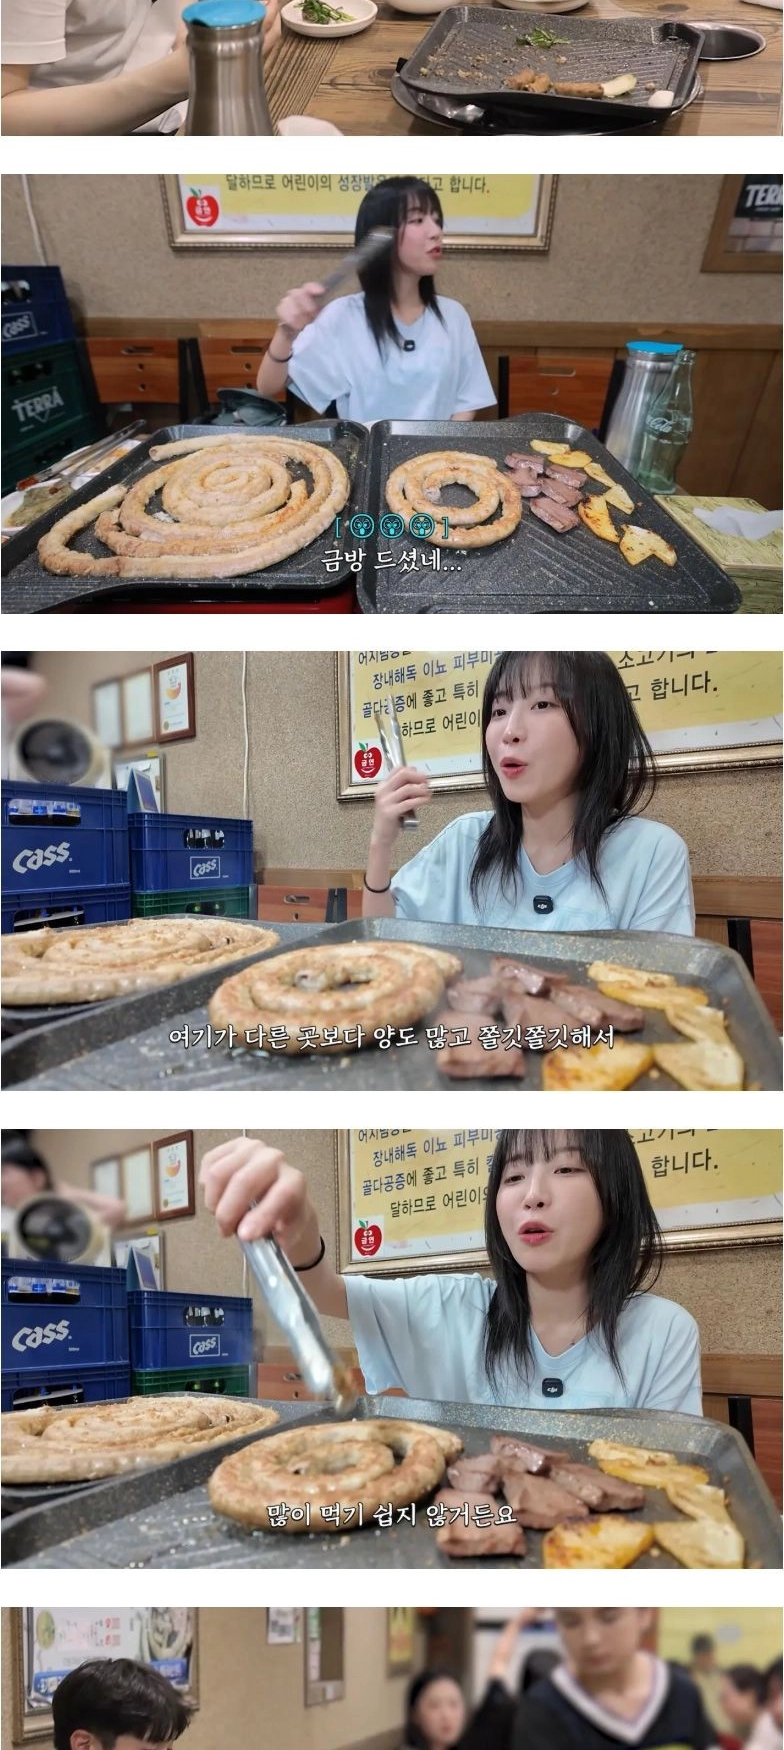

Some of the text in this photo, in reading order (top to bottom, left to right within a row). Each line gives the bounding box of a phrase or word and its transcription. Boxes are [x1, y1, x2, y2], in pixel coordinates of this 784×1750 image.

[225, 174, 276, 191] 달하므로
[281, 174, 332, 191] 어린이의
[11, 386, 64, 422] TERRA
[373, 660, 448, 689] 장내해독 이뇨
[651, 670, 718, 698] 합니다.
[423, 680, 479, 706] 좋고 특히
[442, 708, 482, 731] 어린이
[13, 841, 73, 874] Cass
[193, 859, 217, 877] Cass
[373, 1137, 448, 1168] 장내해독 이뇨
[651, 1148, 718, 1178] 합니다.
[362, 1158, 479, 1197] 골다공증에 좋고 특히
[390, 1191, 436, 1218] 달하므로
[12, 1319, 73, 1353] Cass
[192, 1337, 217, 1356] Cass
